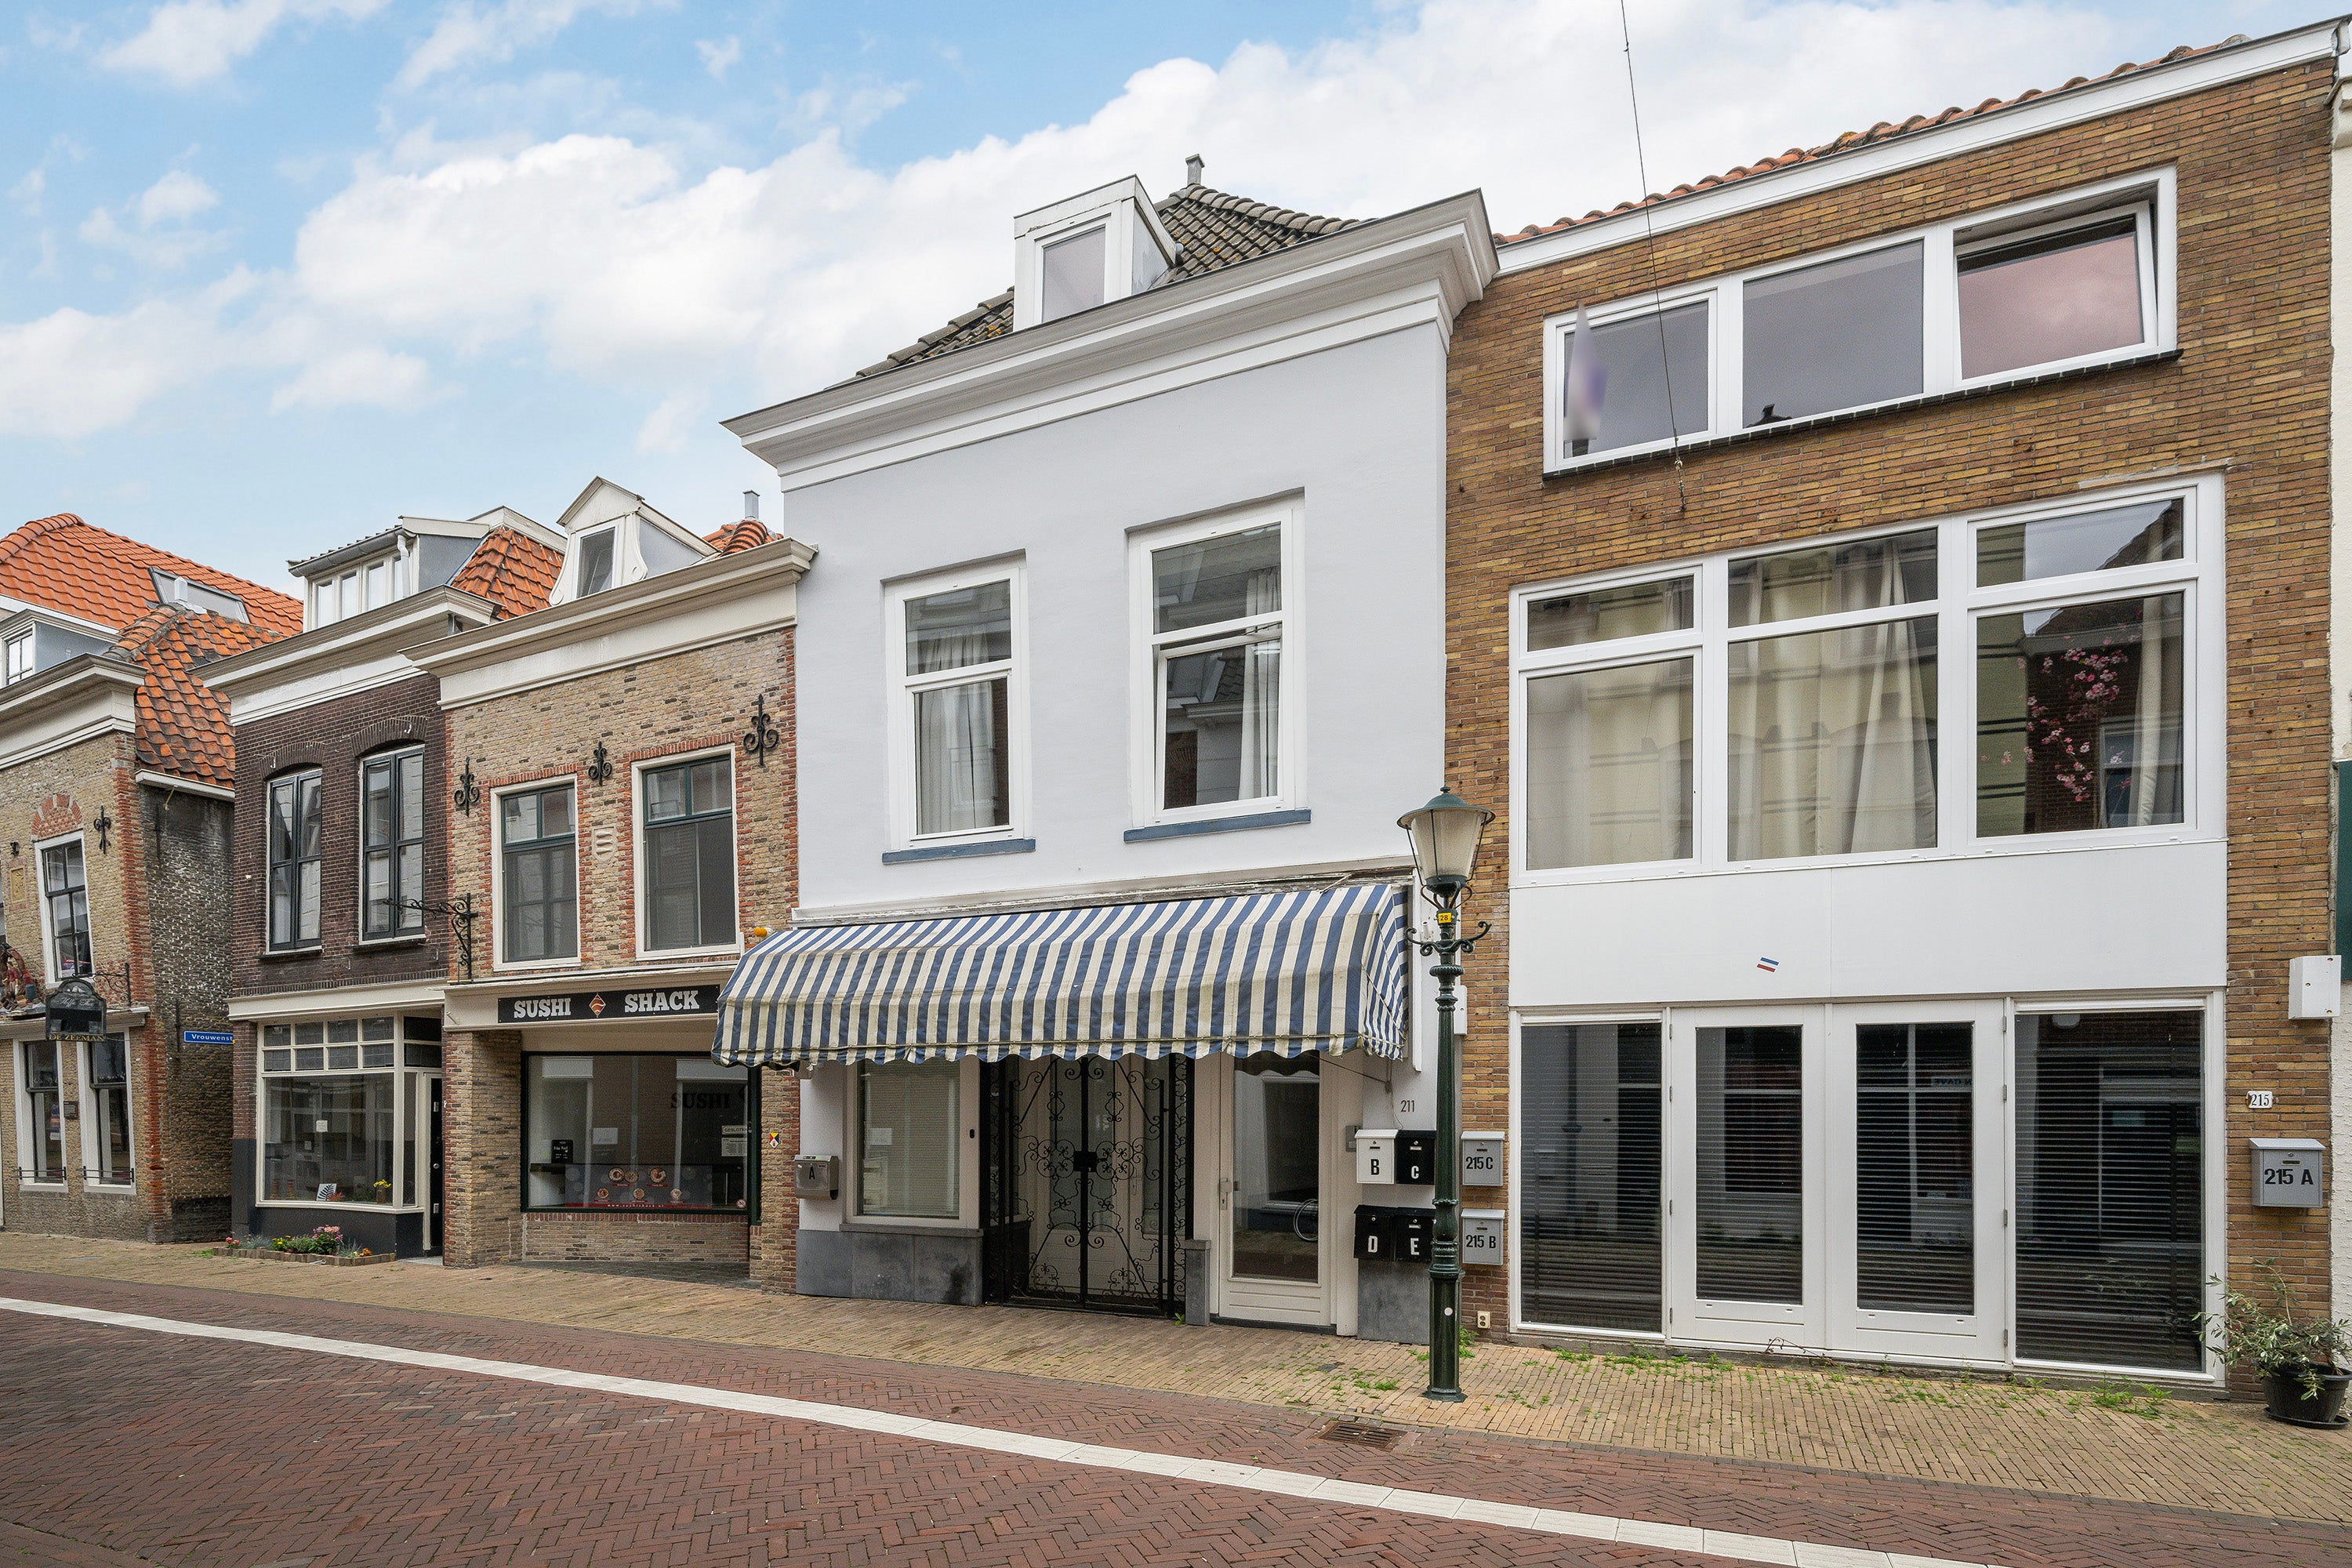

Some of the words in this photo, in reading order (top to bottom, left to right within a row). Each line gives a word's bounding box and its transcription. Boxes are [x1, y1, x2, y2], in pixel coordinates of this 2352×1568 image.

[514, 998, 572, 1018] SUSHI
[624, 990, 700, 1013] SHACK
[670, 1092, 731, 1109] SUSHI
[1400, 1100, 1415, 1112] 211
[2251, 1094, 2270, 1106] 215
[1370, 1159, 1380, 1175] B
[1466, 1156, 1484, 1169] 215
[1486, 1156, 1494, 1169] C
[809, 1166, 815, 1179] A
[1411, 1165, 1420, 1179] C
[2264, 1168, 2294, 1185] 215
[2301, 1169, 2314, 1185] A
[1368, 1236, 1377, 1253] D
[1410, 1238, 1420, 1255] E
[1466, 1235, 1484, 1247] 215
[1489, 1236, 1497, 1248] B
